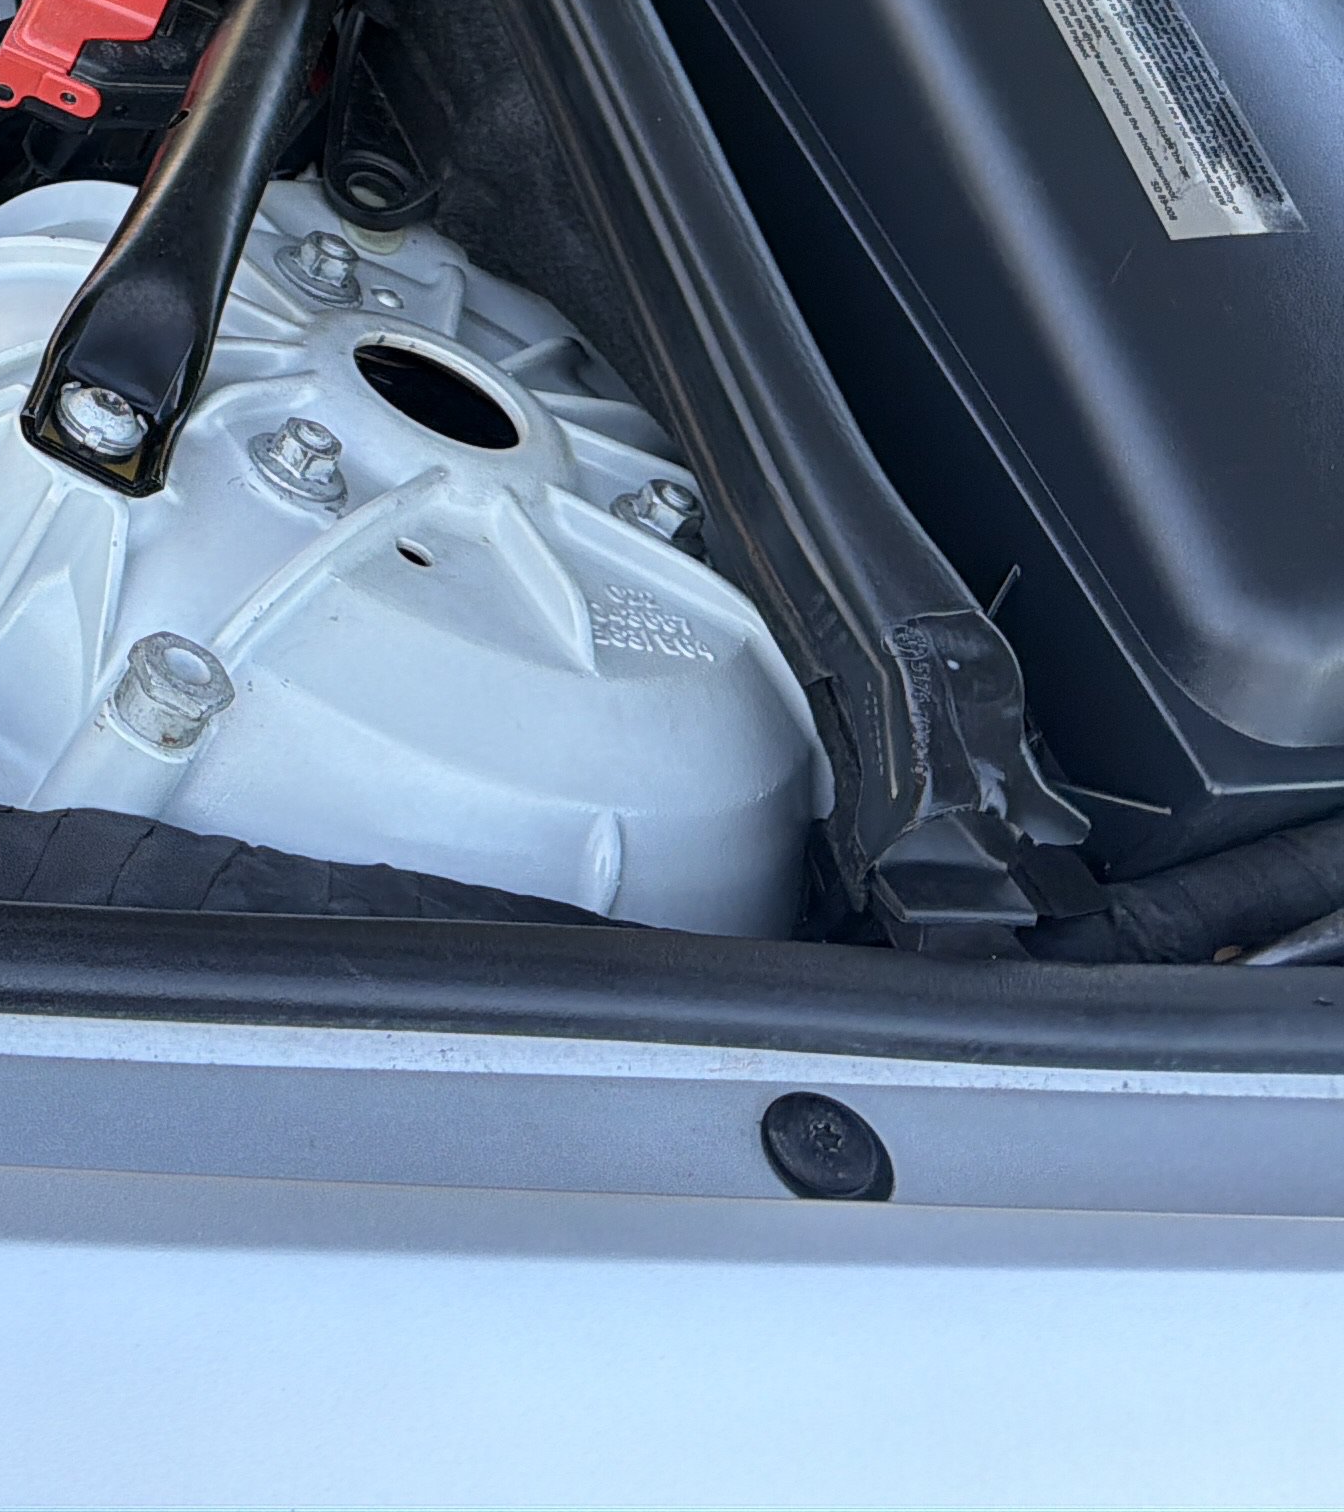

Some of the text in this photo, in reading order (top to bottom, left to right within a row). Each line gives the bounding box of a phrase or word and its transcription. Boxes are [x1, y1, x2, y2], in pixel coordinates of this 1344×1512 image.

[1054, 3, 1065, 13] are
[1061, 16, 1073, 27] not
[1073, 18, 1085, 29] the
[1080, 31, 1101, 58] driver's
[1097, 60, 1111, 76] seat
[1110, 88, 1132, 115] closing
[1128, 118, 1140, 129] the
[1091, 8, 1105, 22] lock
[1100, 25, 1118, 45] doors
[1118, 57, 1135, 76] trunk
[1130, 78, 1145, 93] with
[1139, 96, 1160, 123] anyone
[1156, 126, 1175, 149] inside
[1170, 151, 1183, 163] the
